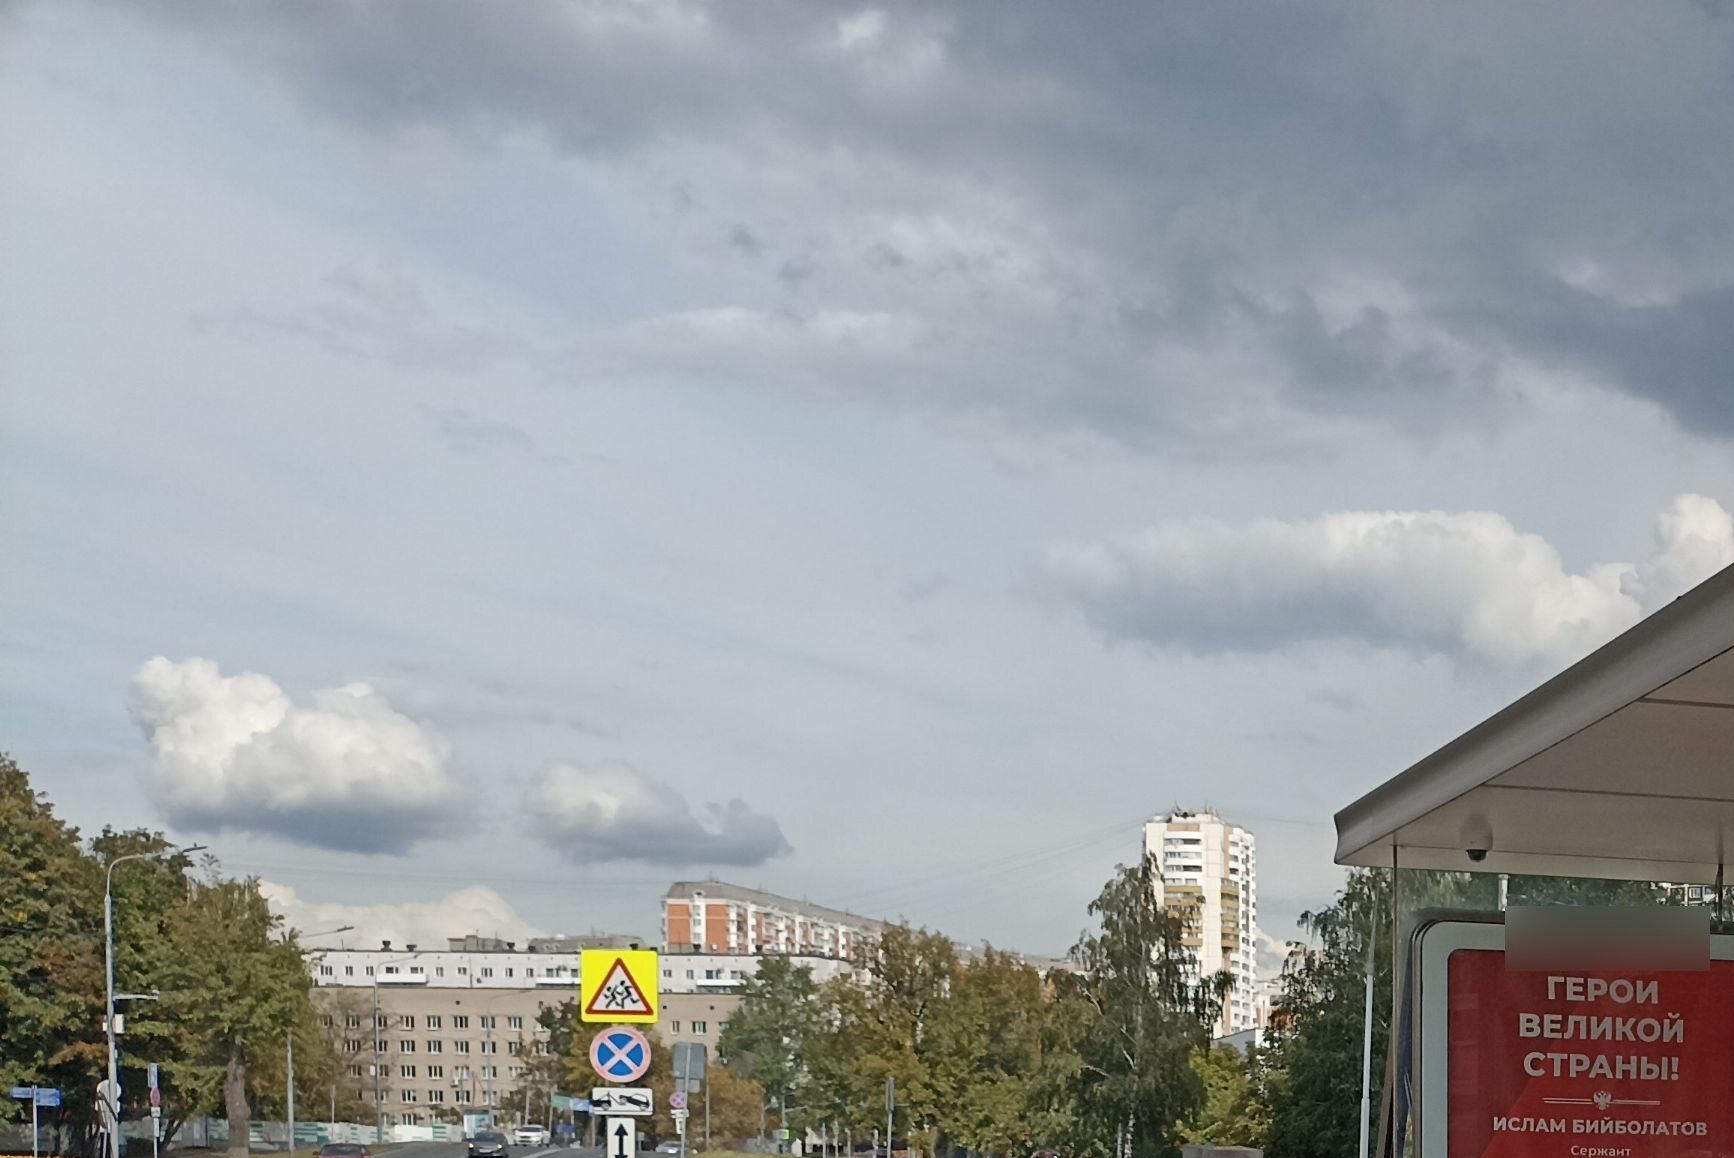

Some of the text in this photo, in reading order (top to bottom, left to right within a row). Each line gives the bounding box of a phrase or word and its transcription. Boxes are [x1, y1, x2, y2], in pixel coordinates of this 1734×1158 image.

[1547, 976, 1659, 1004] ГЕРОИ
[1519, 1012, 1684, 1043] ВЕЛИКОЙ
[1523, 1052, 1680, 1081] СТРАНЫ!
[1492, 1117, 1708, 1136] ИСЛАМ БИЙБОЛАТОВ
[1570, 1145, 1632, 1158] Сержант
